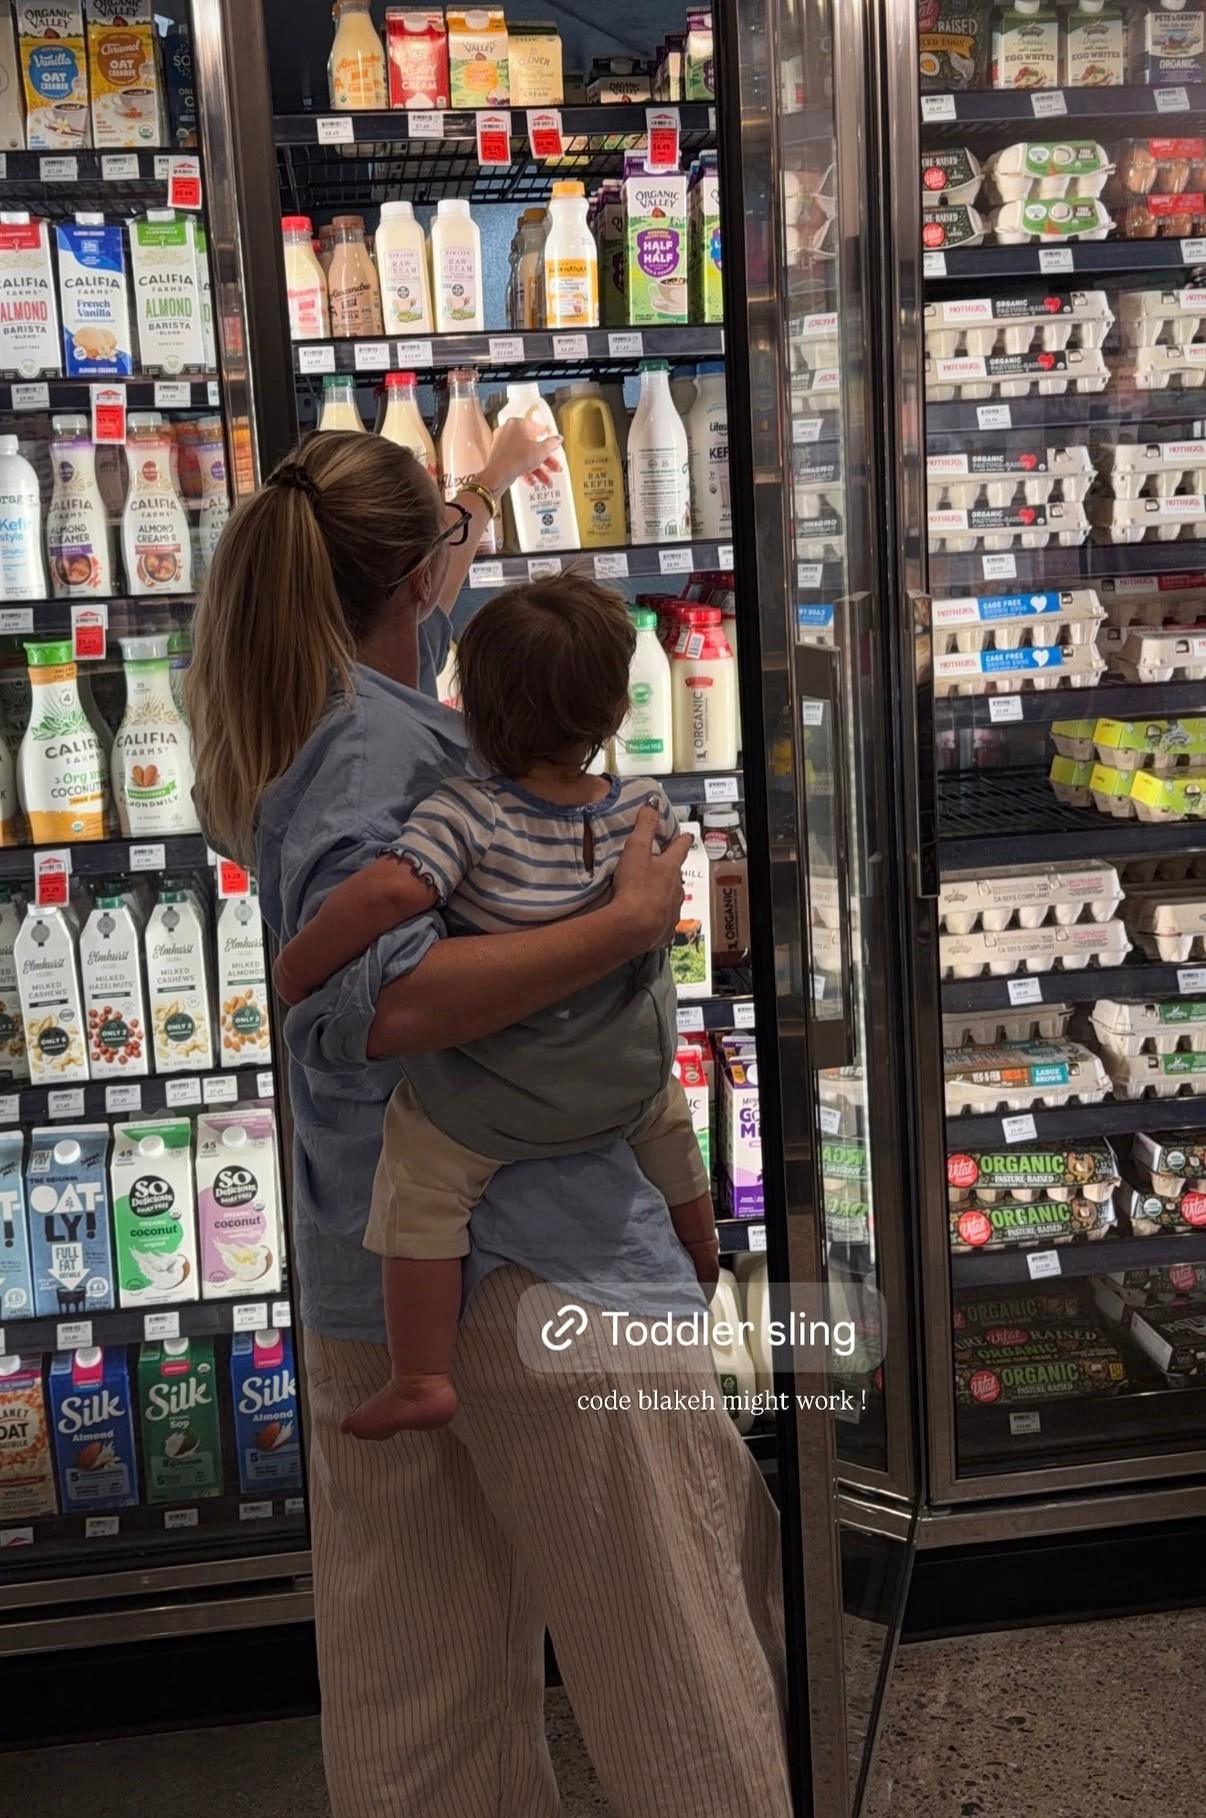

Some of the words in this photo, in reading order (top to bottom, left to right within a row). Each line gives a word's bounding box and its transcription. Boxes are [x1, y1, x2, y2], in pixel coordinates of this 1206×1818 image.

[24, 8, 74, 21] ORGANIC
[99, 6, 140, 17] VALLEY
[30, 17, 70, 29] VALLEY
[938, 17, 979, 35] RAISED
[33, 53, 72, 67] Vanilla
[1005, 54, 1024, 62] EGG
[1024, 53, 1055, 61] WHITES
[1090, 51, 1120, 60] WHITES
[109, 60, 134, 69] OAT
[1159, 59, 1194, 69] ORGANIC
[41, 72, 67, 82] OAT
[402, 80, 437, 91] CREAM
[635, 190, 680, 202] ORGANIC
[639, 198, 676, 208] VALLEY
[643, 241, 673, 250] HALF
[644, 253, 673, 263] HALF
[64, 276, 120, 289] CALIFIA
[138, 274, 194, 286] CALIFIA
[77, 300, 110, 308] French
[145, 297, 192, 319] ALMOND
[996, 299, 1028, 307] ORGANIC
[0, 301, 48, 322] ALMOND
[77, 309, 111, 317] Vanilla
[3, 326, 47, 335] BARISTA
[148, 322, 191, 331] BARISTA
[989, 357, 1022, 365] ORGANIC
[972, 455, 1005, 463] ORGANIC
[588, 472, 608, 480] RAW
[583, 480, 614, 489] KEFIR
[529, 490, 561, 501] KEFIR
[130, 498, 177, 511] CALIFIA
[971, 510, 1004, 518] ORGANIC
[50, 523, 87, 534] ALMOND
[139, 524, 174, 533] ALMOND
[983, 601, 1002, 609] CAGE
[1003, 599, 1022, 607] FREE
[985, 654, 1004, 662] CAGE
[1005, 652, 1024, 661] FREE
[63, 694, 70, 703] 4
[693, 691, 704, 748] ORGANIC
[117, 732, 178, 748] CALIFIA
[126, 748, 164, 757] FARMS
[51, 781, 103, 798] COCONUT
[1017, 892, 1050, 900] COMPLIANT
[725, 887, 734, 939] ORGANIC
[152, 942, 194, 960] Elmhurst
[1022, 944, 1055, 952] COMPLIANT
[87, 948, 129, 966] Elmhurst
[22, 957, 66, 975] Elmhurst
[231, 961, 260, 969] MILKED
[160, 967, 190, 976] MILKED
[227, 968, 264, 977] ALMONDS
[95, 974, 125, 982] MILKED
[157, 974, 195, 985] CASHEWS
[31, 981, 62, 991] MILKED
[89, 980, 133, 991] HAZELNUTS
[27, 989, 67, 1000] CASHEWS
[167, 1023, 187, 1031] ONLY
[101, 1029, 122, 1037] ONLY
[40, 1036, 60, 1045] ONLY
[1035, 1075, 1062, 1083] BROWN
[202, 1141, 217, 1150] 45
[119, 1149, 133, 1158] 45
[948, 1160, 974, 1178] Vital
[980, 1154, 1066, 1174] ORGANIC
[46, 1175, 78, 1183] ORIGINAL
[218, 1170, 252, 1188] SO
[134, 1180, 169, 1198] SO
[215, 1183, 257, 1198] Delicious
[131, 1193, 173, 1207] Delicious
[991, 1203, 1070, 1228] ORGANIC
[44, 1212, 97, 1243] LY!
[214, 1215, 262, 1229] coconut
[960, 1218, 985, 1237] Vital
[130, 1225, 178, 1238] coconut
[1037, 1224, 1063, 1234] RAISED
[55, 1247, 79, 1259] FULL
[59, 1260, 76, 1271] FAT
[1170, 1265, 1195, 1282] Vital
[967, 1300, 1037, 1321] ORGANIC
[1030, 1329, 1097, 1341] RAISED
[977, 1342, 1058, 1360] ORGANIC
[1001, 1363, 1079, 1387] ORGANIC
[238, 1369, 296, 1414] Silk
[971, 1379, 997, 1395] Vital
[1047, 1383, 1074, 1393] RAISED
[145, 1377, 212, 1421] Silk
[58, 1390, 126, 1434] Silk
[252, 1409, 294, 1423] Almond
[170, 1420, 190, 1430] Soy
[72, 1429, 115, 1442] Almond
[250, 1452, 258, 1462] 5
[71, 1472, 79, 1482] 5
[156, 1476, 165, 1485] 5
